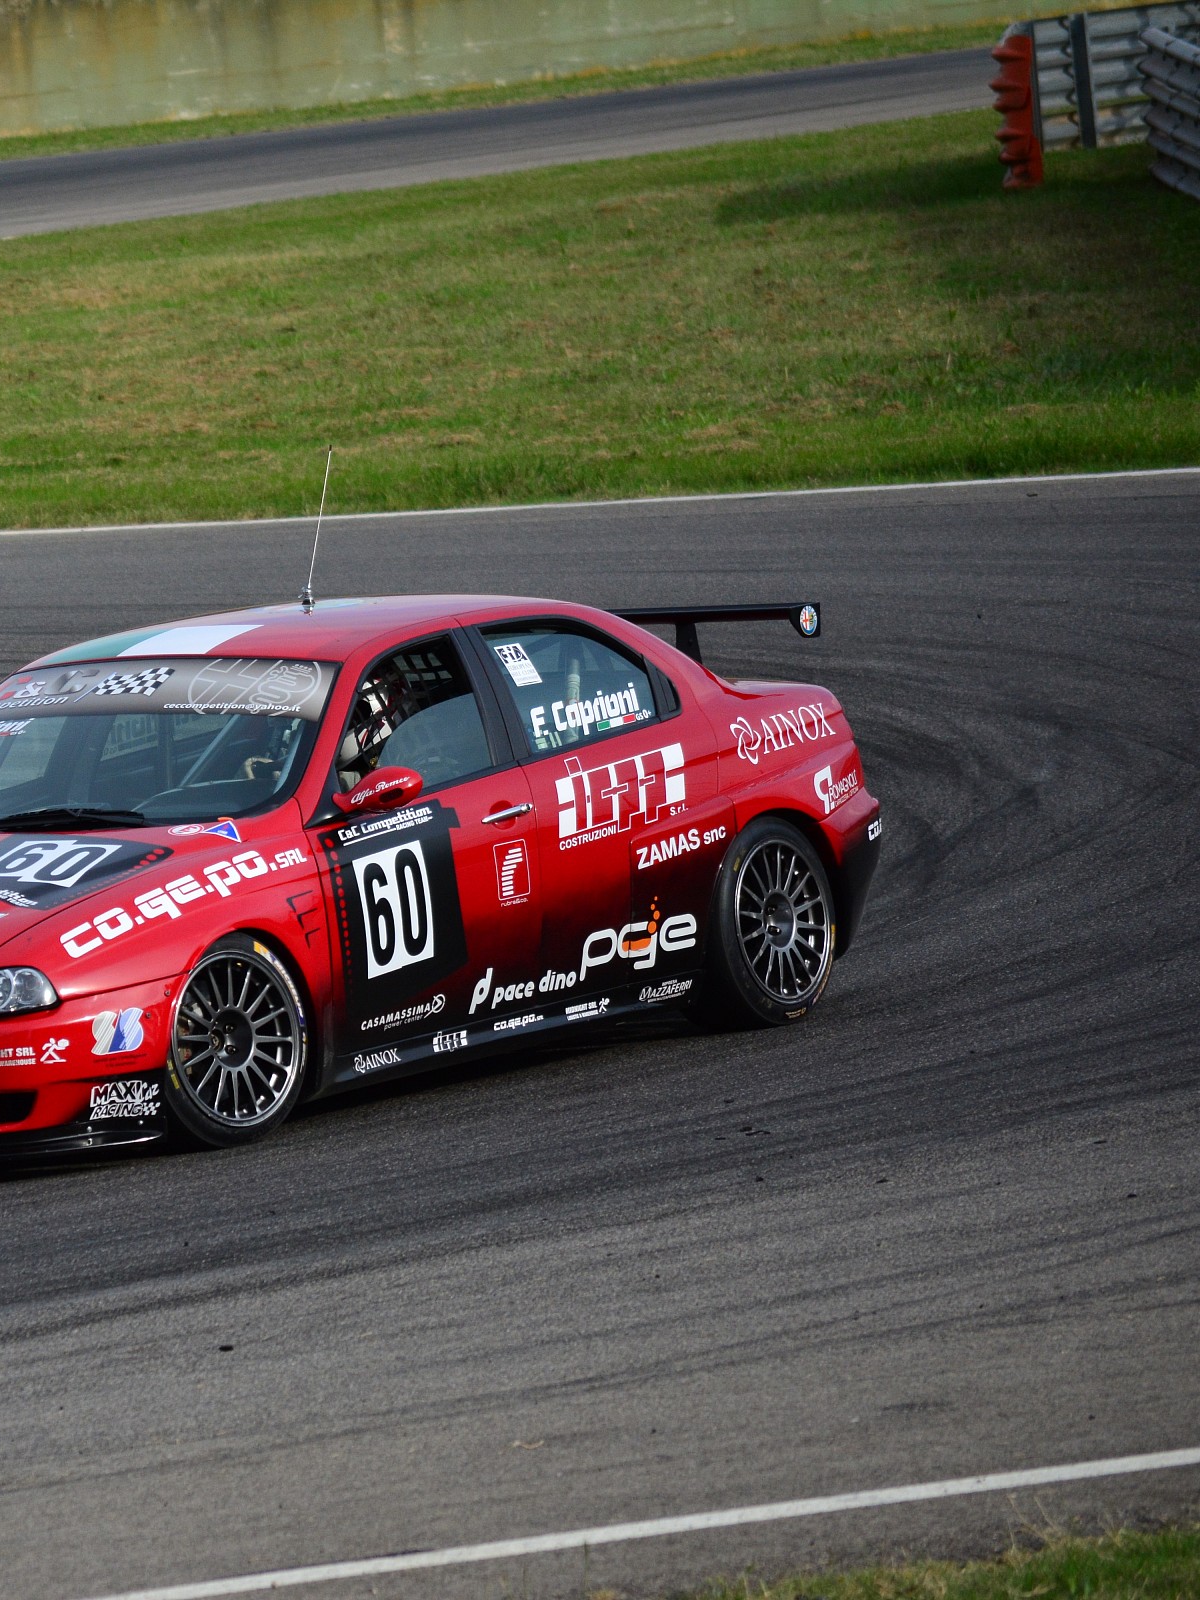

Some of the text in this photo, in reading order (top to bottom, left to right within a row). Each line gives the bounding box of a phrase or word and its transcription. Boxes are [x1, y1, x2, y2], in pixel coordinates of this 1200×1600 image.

[163, 702, 301, 712] ceccompetition@yahoo.it
[531, 682, 639, 738] F. Caprioni
[761, 703, 836, 754] AINOX
[351, 777, 410, 805] Alfa Romeo
[338, 807, 432, 841] C&C Competition
[559, 825, 617, 851] COSTRUZIONI
[636, 829, 700, 870] ZAMAS
[703, 826, 726, 845] snc
[363, 848, 428, 966] 60
[491, 970, 576, 1009] pace dino
[639, 979, 692, 1001] MAZZAFERRI
[361, 1003, 430, 1030] CASAMASSIMA
[384, 1014, 423, 1031] power center
[15, 1047, 35, 1057] SRL
[366, 1048, 401, 1070] AINOX
[90, 1102, 143, 1120] RACING
